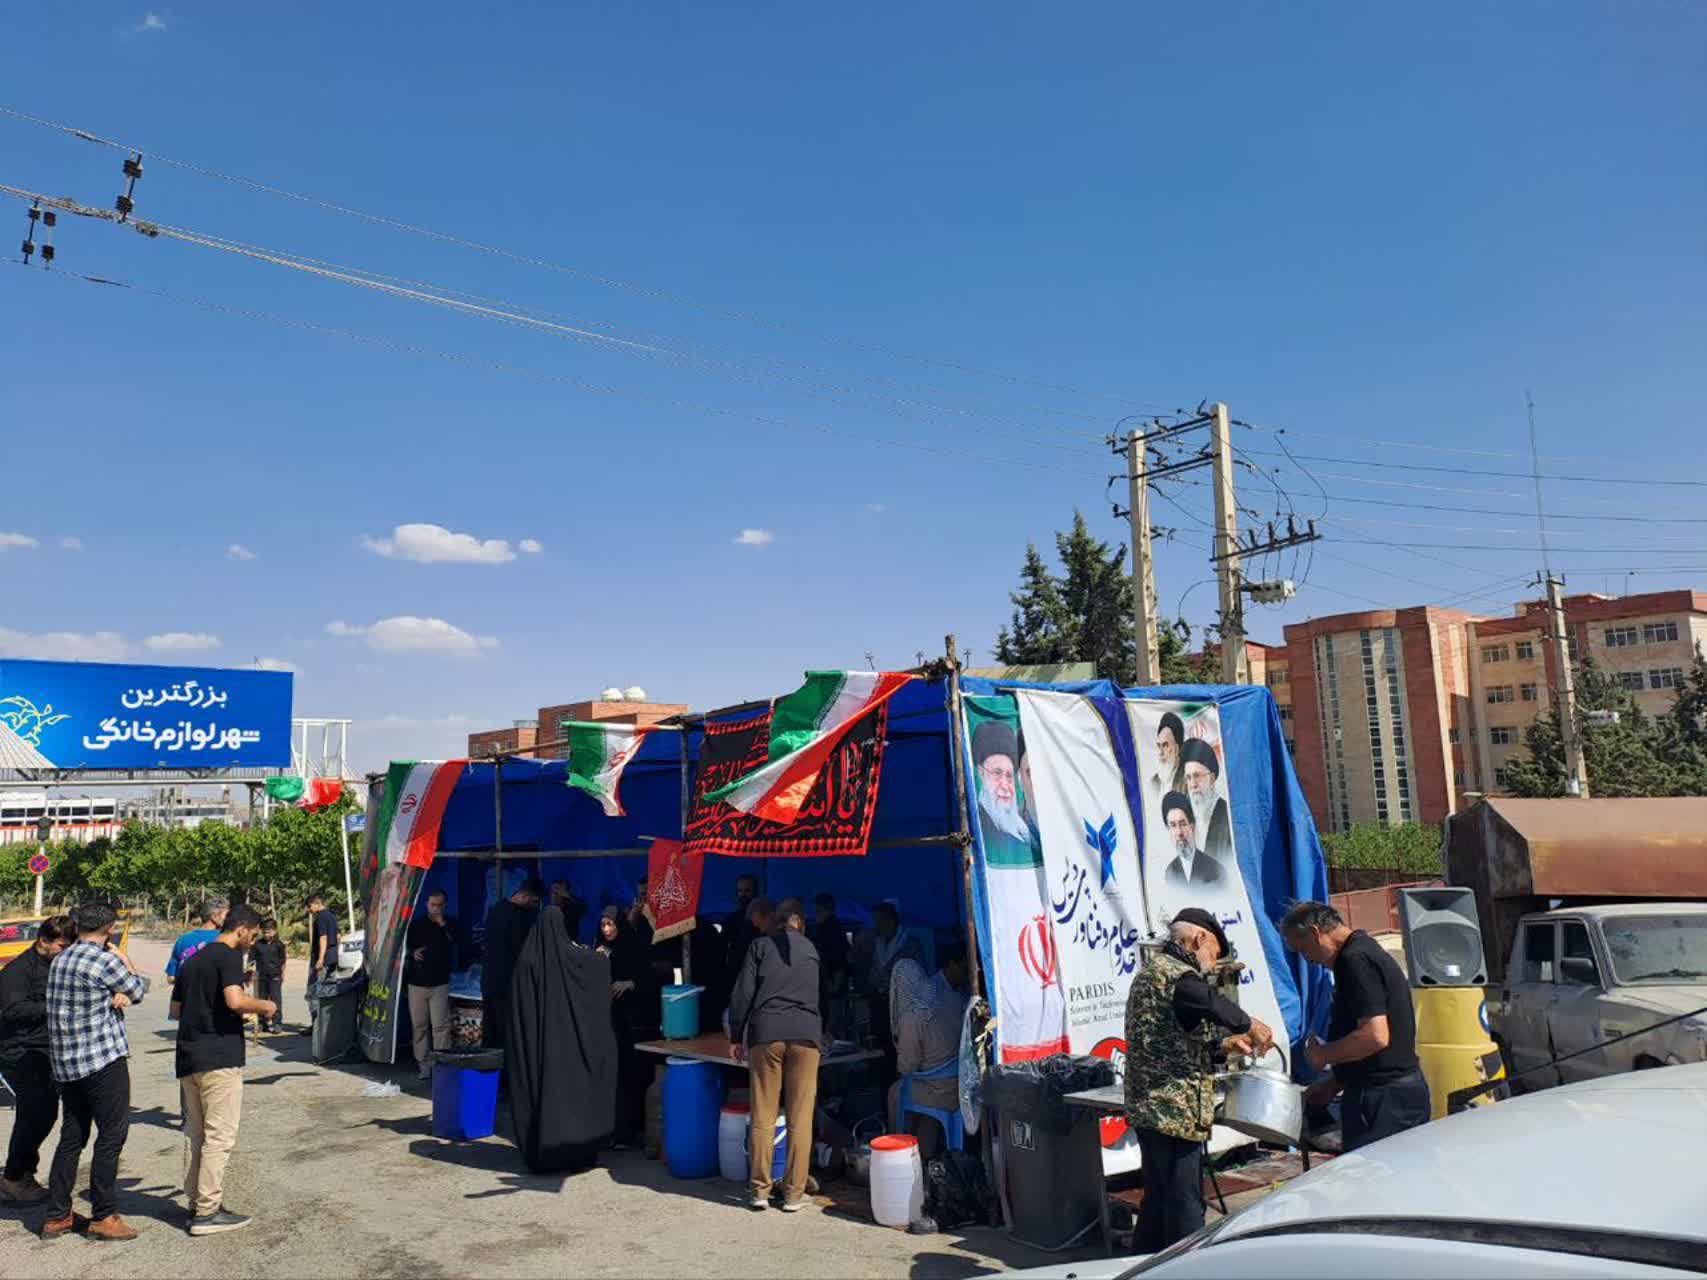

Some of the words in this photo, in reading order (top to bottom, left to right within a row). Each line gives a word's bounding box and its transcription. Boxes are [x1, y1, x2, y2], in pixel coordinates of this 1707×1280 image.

[121, 680, 228, 709] بزرگترین
[83, 717, 156, 750] خانگی
[154, 721, 216, 751] لوازم
[210, 728, 260, 750] شهر
[1069, 982, 1115, 1003] PARDIS
